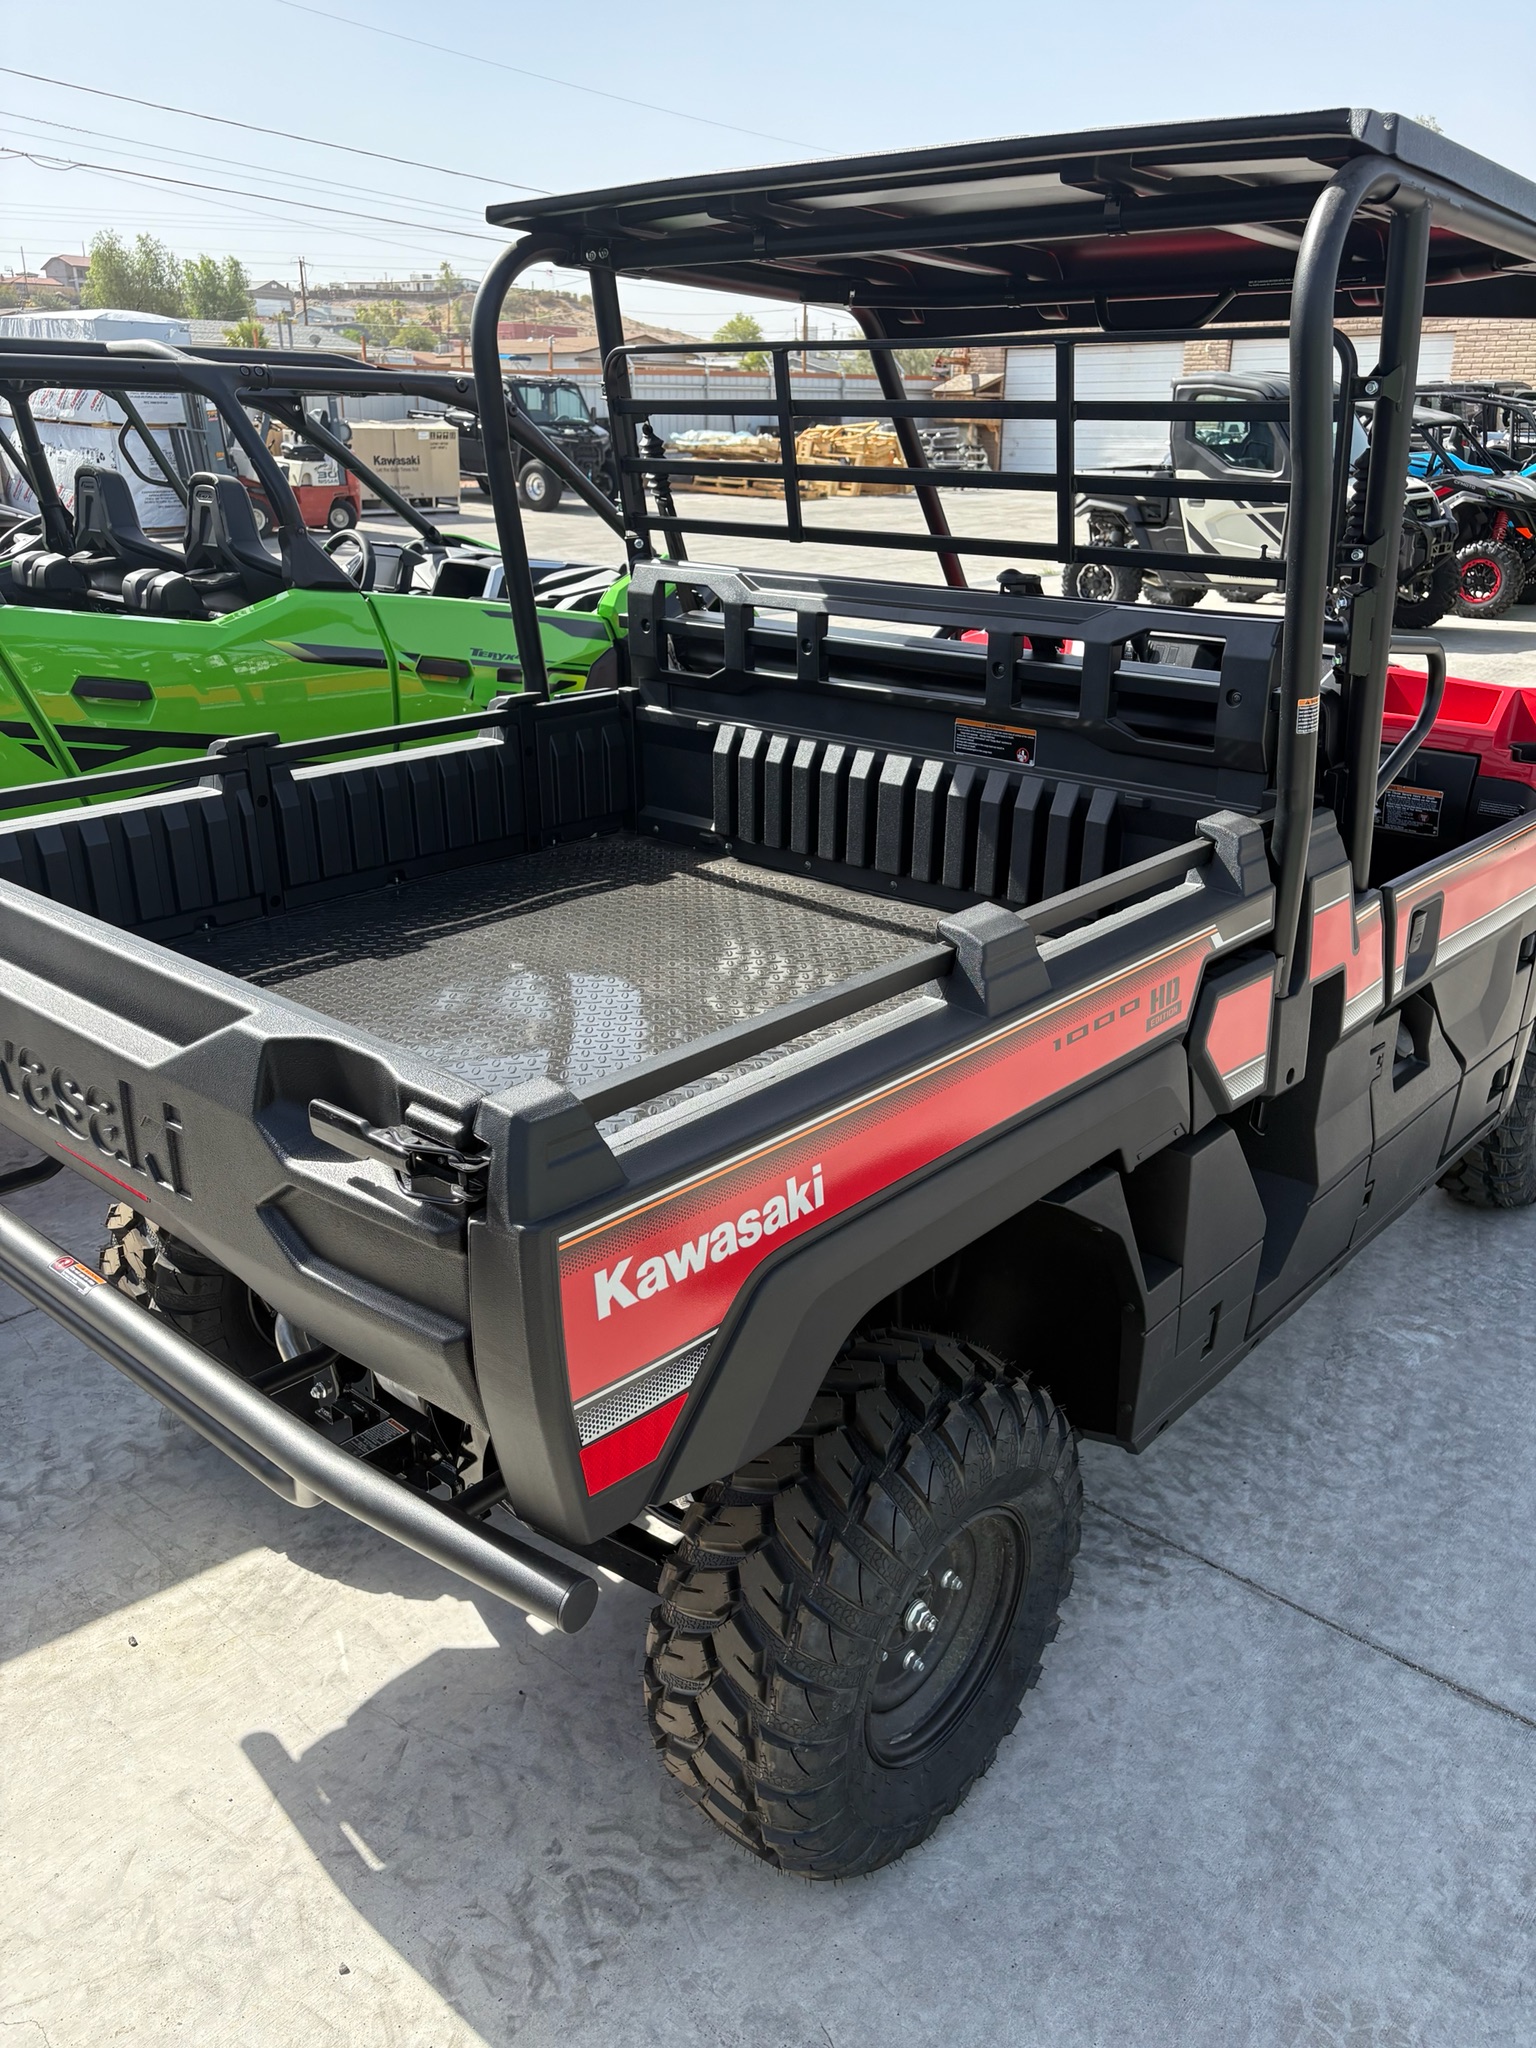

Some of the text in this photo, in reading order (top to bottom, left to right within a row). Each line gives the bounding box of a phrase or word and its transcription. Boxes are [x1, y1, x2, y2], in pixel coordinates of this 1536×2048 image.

[373, 455, 421, 466] Kawasaki
[1053, 976, 1180, 1052] 1000 HD
[1150, 1004, 1179, 1027] EDITION
[593, 1162, 825, 1321] Kawasaki
